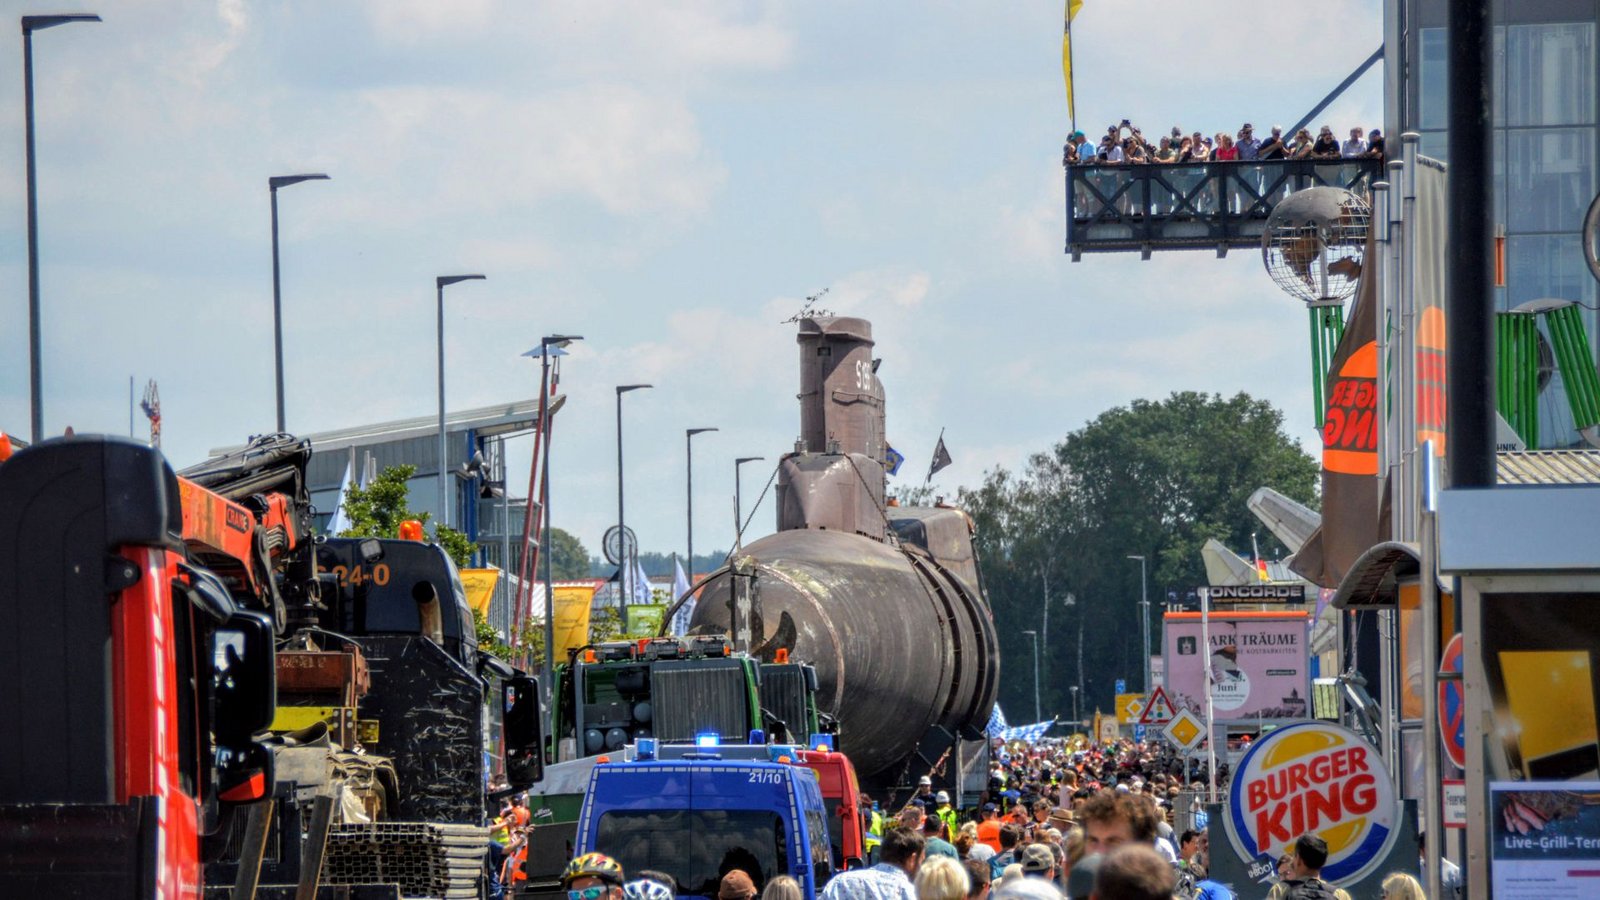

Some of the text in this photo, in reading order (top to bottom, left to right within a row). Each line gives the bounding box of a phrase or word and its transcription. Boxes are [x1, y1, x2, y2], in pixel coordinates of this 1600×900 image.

[1241, 631, 1298, 645] TRÄUME
[1217, 683, 1237, 692] Juni
[749, 773, 781, 784] 21/10
[1247, 746, 1369, 813] BURGER
[1256, 773, 1377, 852] KING
